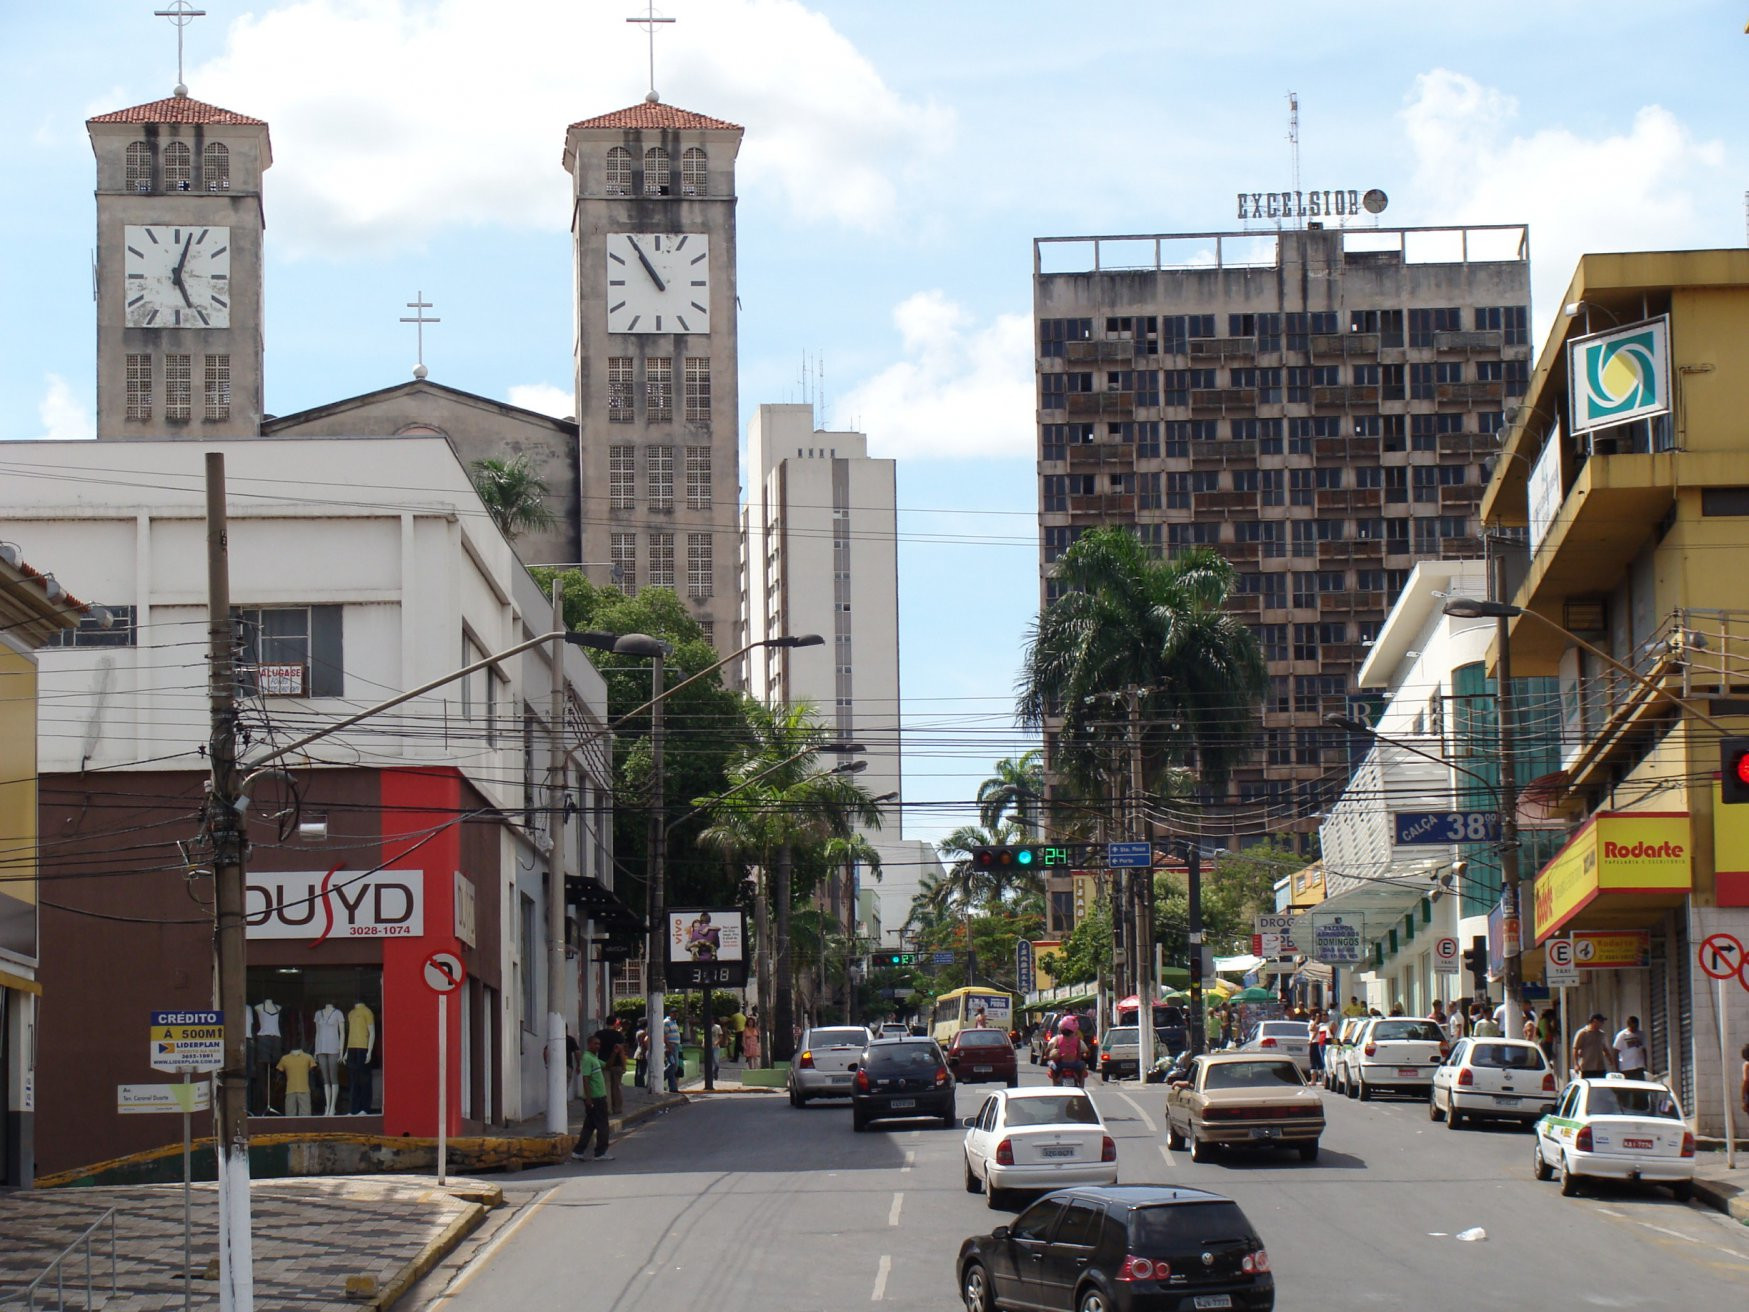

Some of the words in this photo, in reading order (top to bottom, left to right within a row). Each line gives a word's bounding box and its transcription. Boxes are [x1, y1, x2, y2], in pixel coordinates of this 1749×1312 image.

[1237, 190, 1358, 219] EXCELSIOR
[1402, 814, 1438, 841] CALÇA
[1045, 848, 1067, 865] 24
[1604, 841, 1684, 858] Rodarte
[350, 926, 411, 935] 3028-1074
[672, 919, 682, 944] vivo
[1318, 938, 1360, 946] DOMINGOS
[1442, 942, 1452, 954] E
[1557, 946, 1568, 961] E
[158, 1011, 217, 1024] CRÉDITO
[182, 1029, 216, 1039] 500M
[176, 1041, 220, 1049] LIDERPLAN
